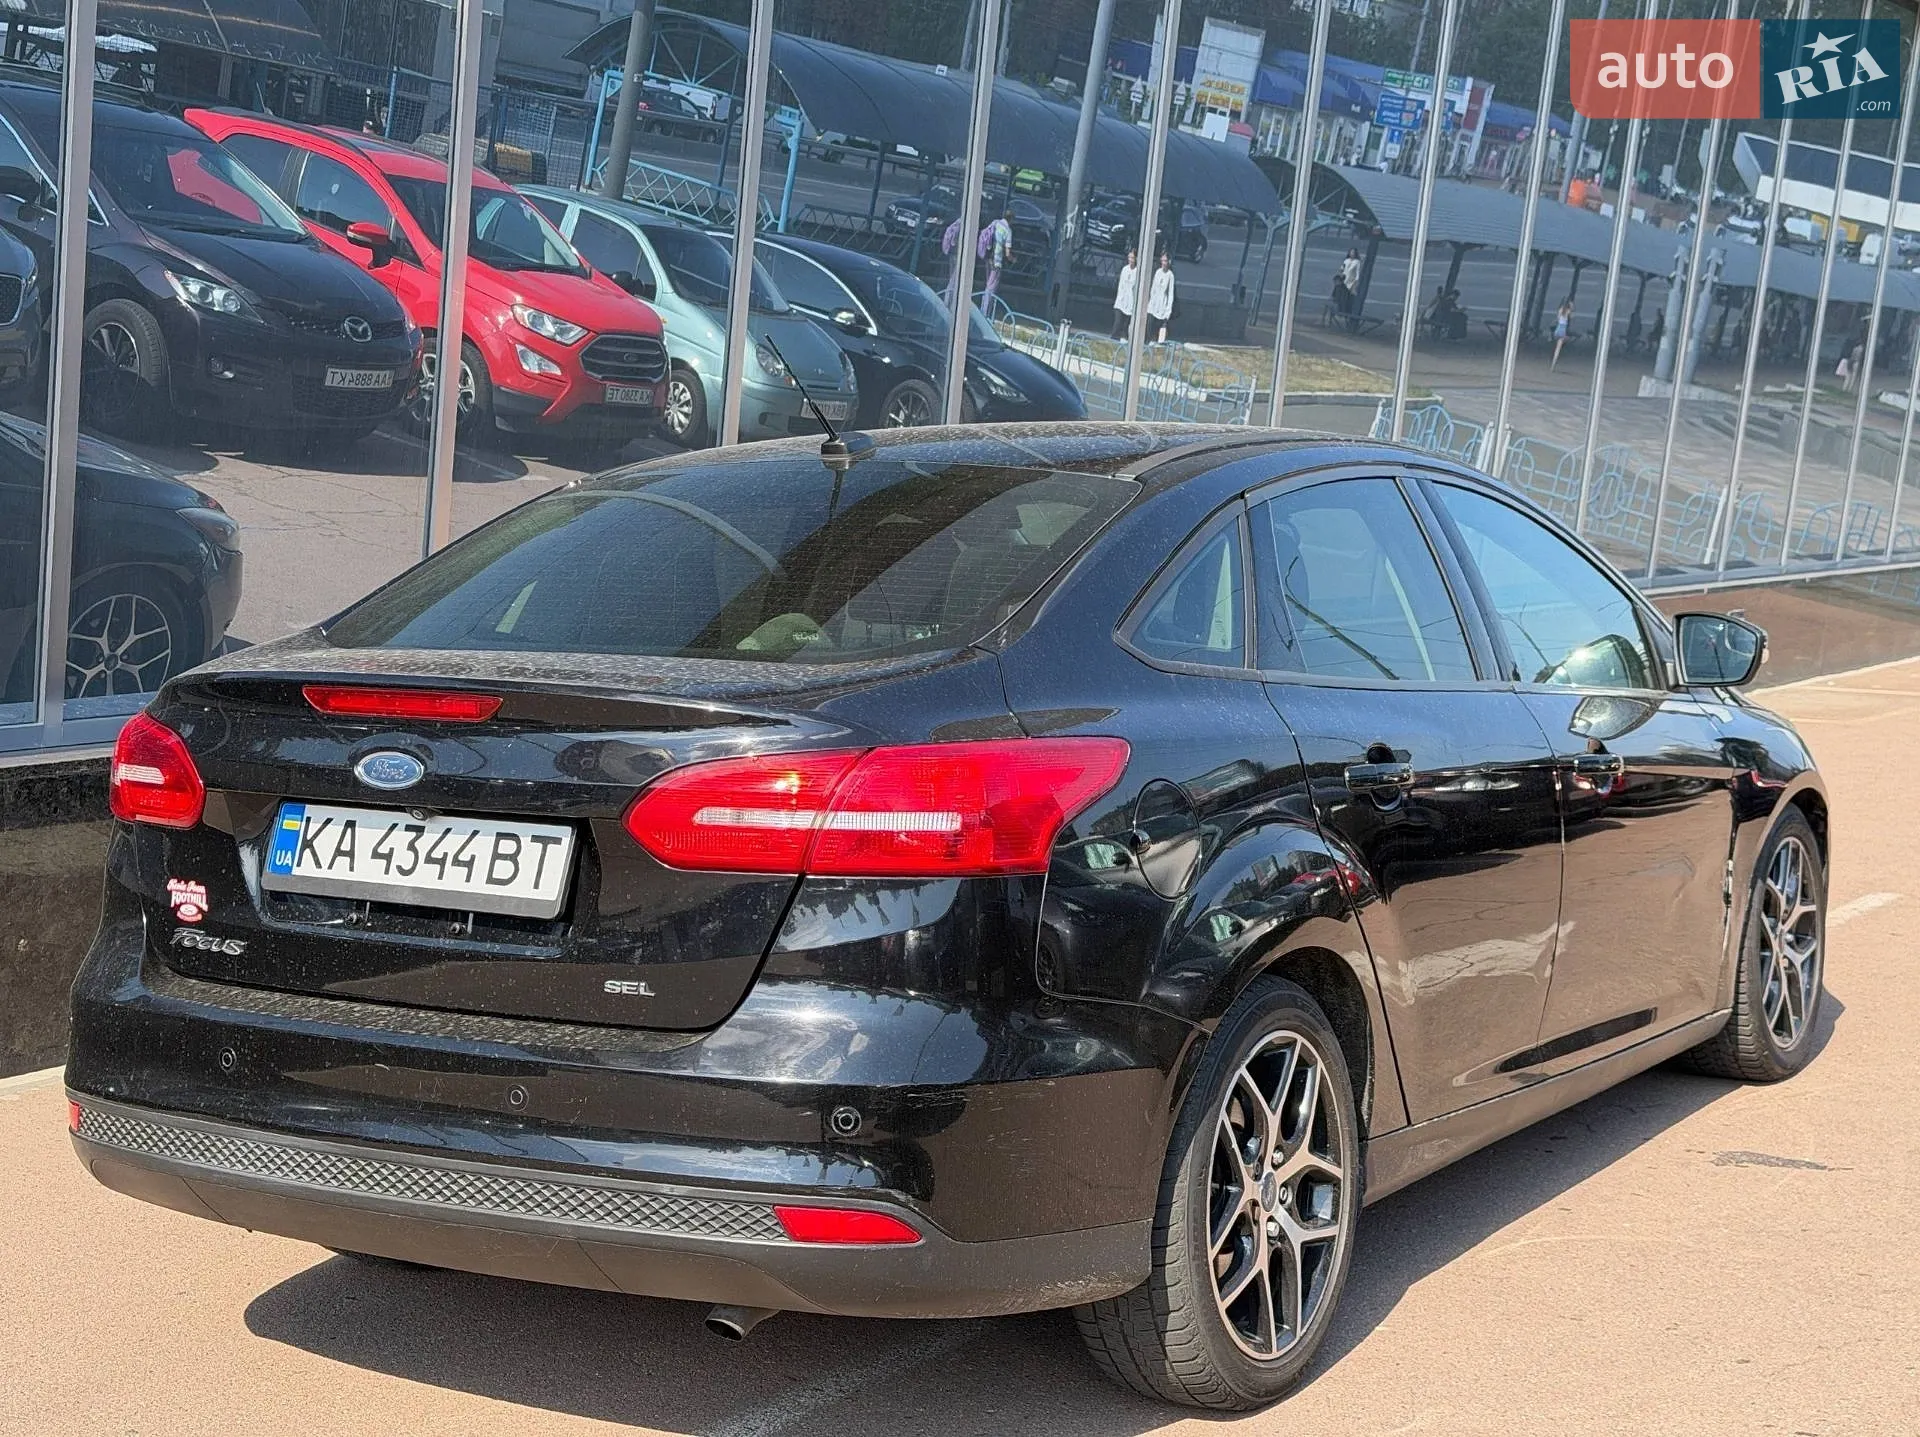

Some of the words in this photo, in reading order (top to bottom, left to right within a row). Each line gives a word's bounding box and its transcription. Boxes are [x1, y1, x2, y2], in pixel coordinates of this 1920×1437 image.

[372, 758, 409, 779] Ford
[275, 850, 292, 867] UA
[296, 816, 357, 872] KA
[370, 822, 480, 883] 4344
[485, 831, 563, 890] BT
[170, 890, 208, 912] FOOTHILL
[604, 980, 656, 997] SEL
